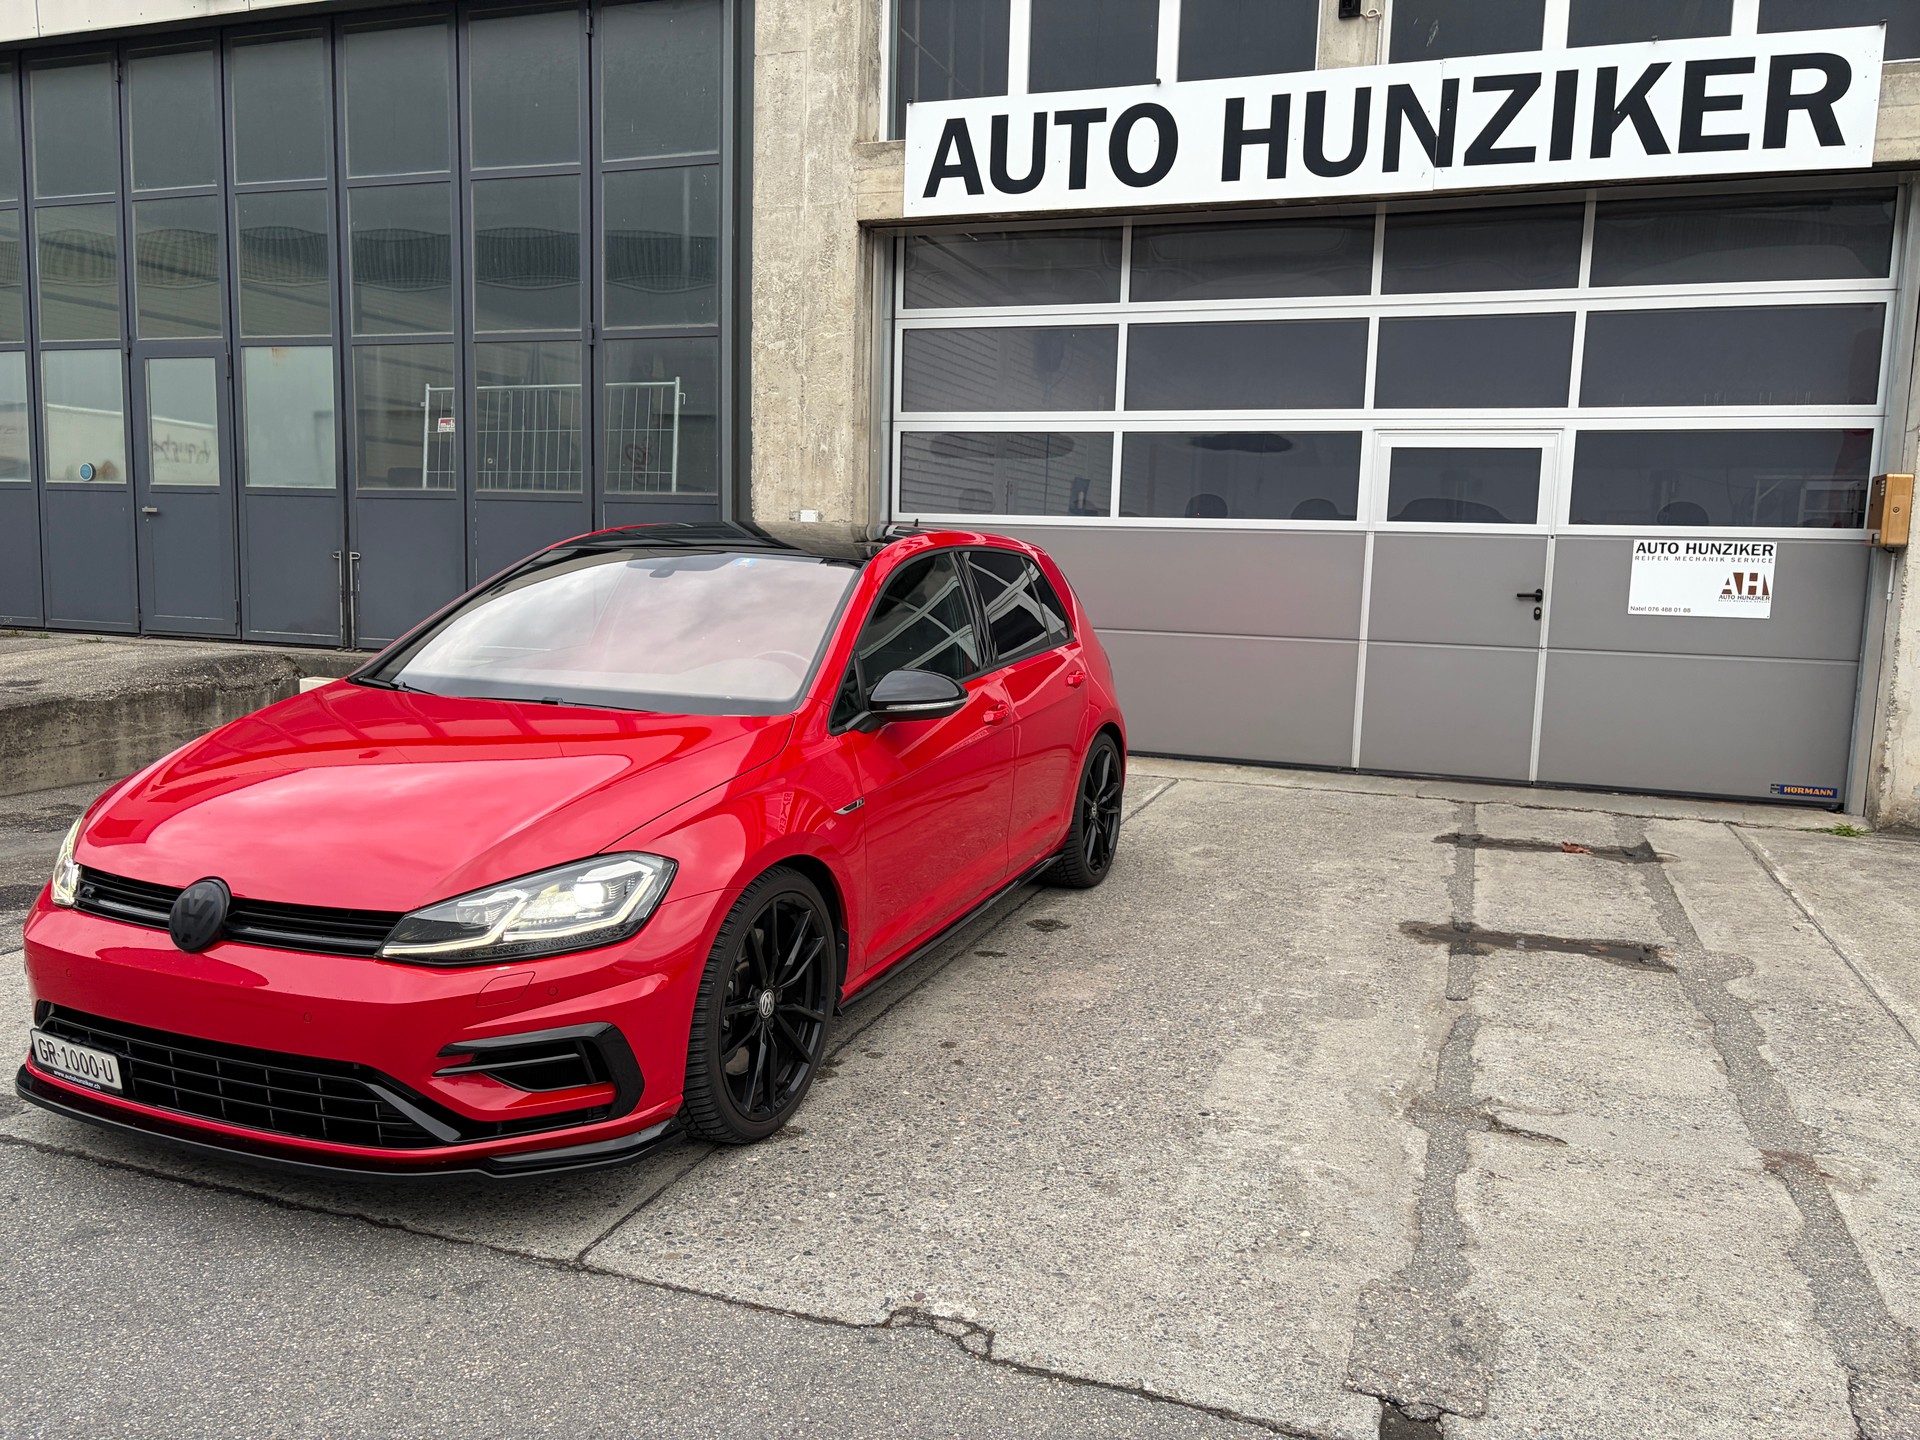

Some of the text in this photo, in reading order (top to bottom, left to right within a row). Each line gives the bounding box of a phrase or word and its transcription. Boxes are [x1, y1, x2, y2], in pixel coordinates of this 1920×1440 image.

[922, 51, 1853, 198] AUTO HUNZIKER
[1635, 541, 1774, 557] AUTO HUNZIKER
